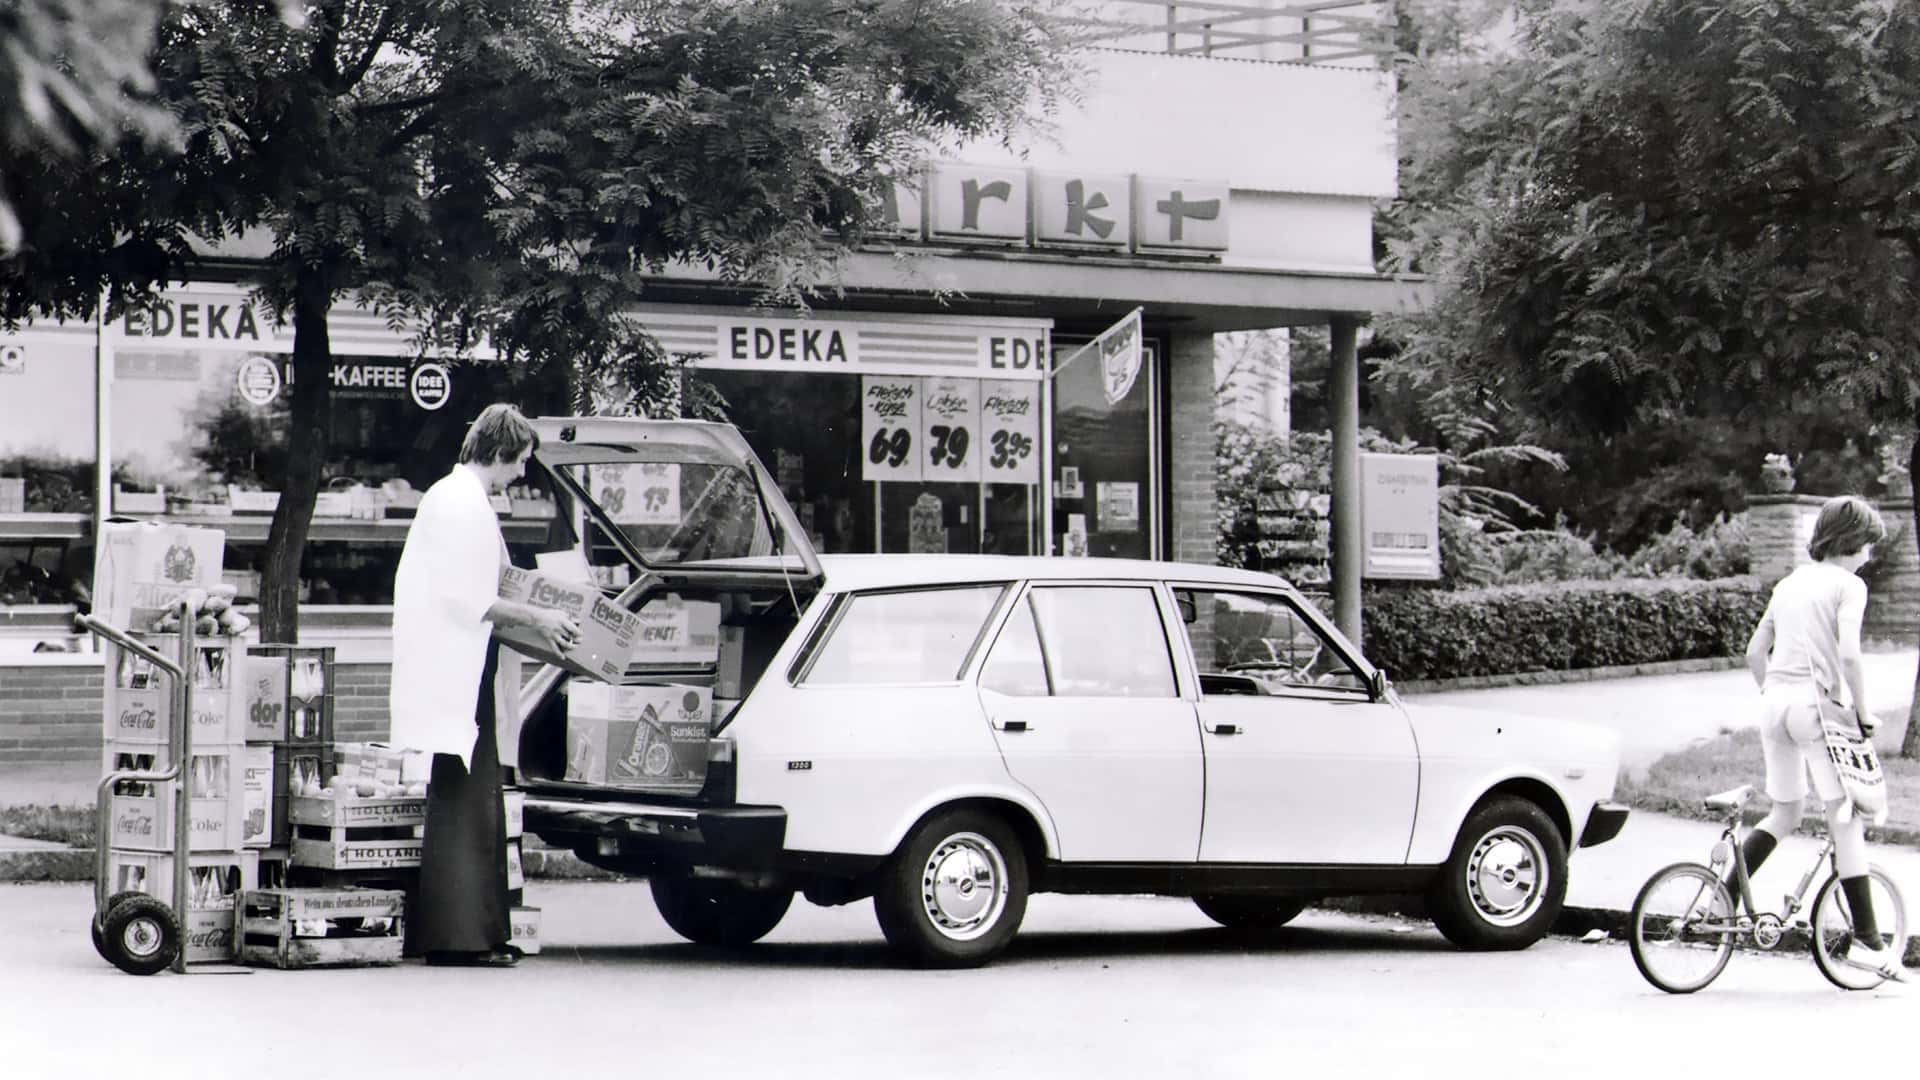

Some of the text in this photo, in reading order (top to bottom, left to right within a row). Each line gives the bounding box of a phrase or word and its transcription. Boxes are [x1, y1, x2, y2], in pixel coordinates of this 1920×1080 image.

[124, 303, 259, 340] EDEKA
[731, 327, 847, 362] EDEKA
[418, 376, 442, 387] IDEE
[990, 429, 1033, 470] 3.95
[528, 577, 584, 605] fewa
[592, 597, 623, 624] fewa
[250, 699, 282, 723] dor
